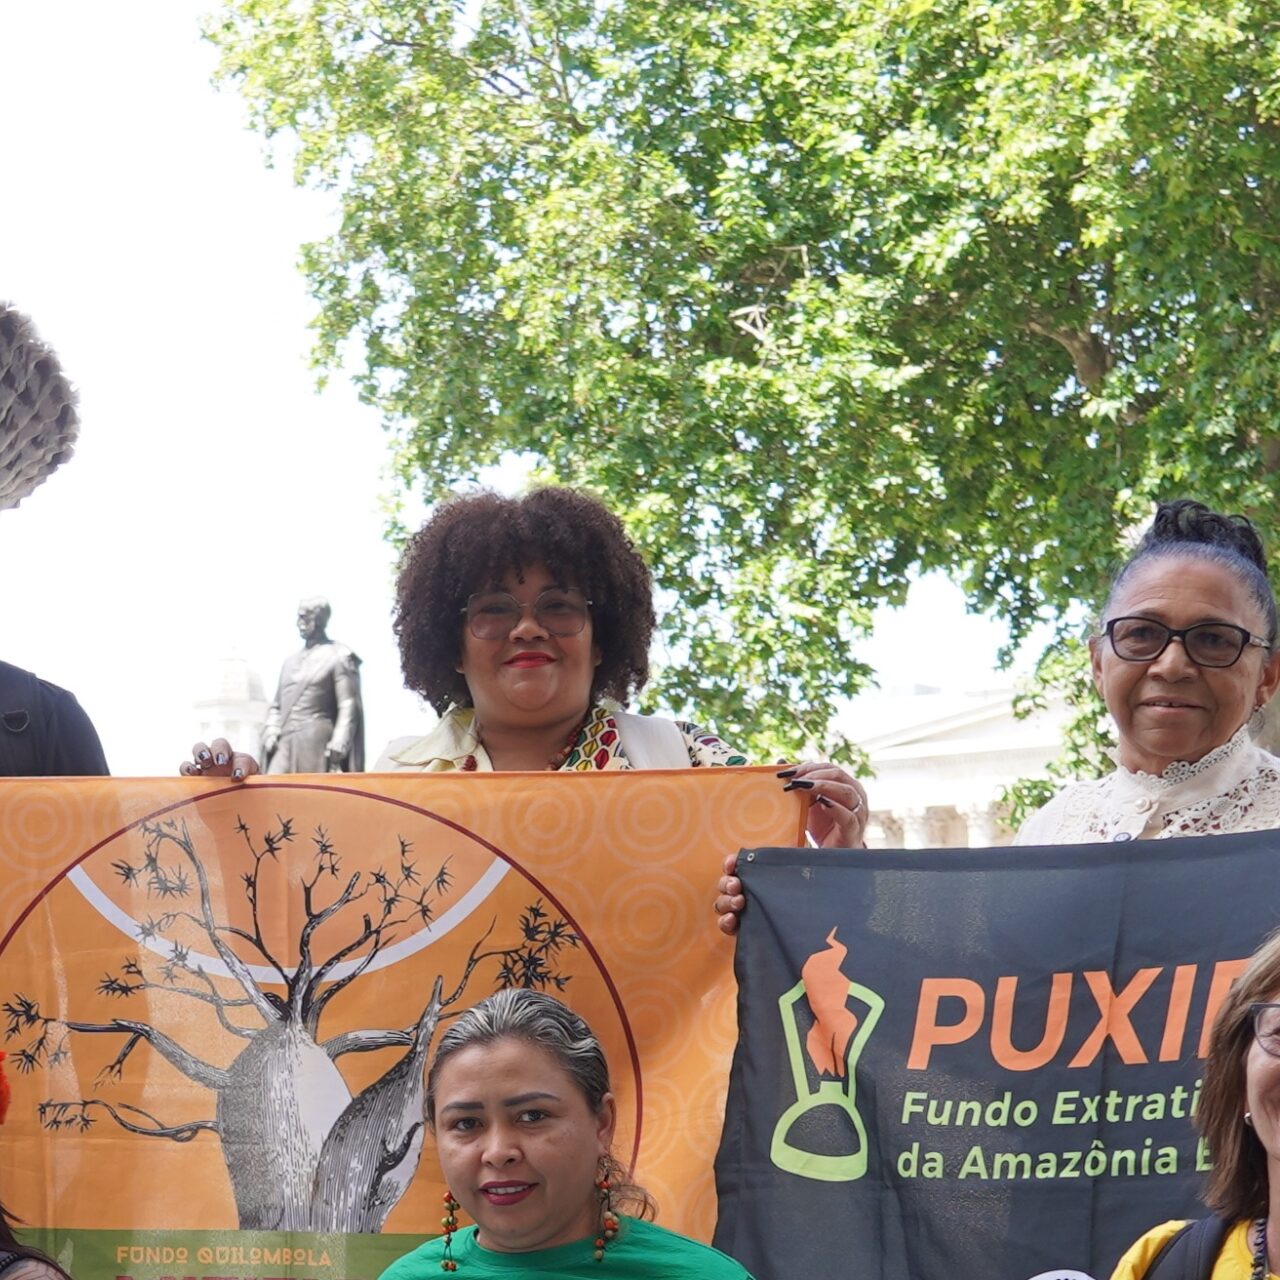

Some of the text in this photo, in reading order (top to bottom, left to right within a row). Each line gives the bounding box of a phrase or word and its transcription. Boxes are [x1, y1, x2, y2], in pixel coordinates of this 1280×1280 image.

[900, 1090, 1038, 1127] Fundo
[897, 1141, 943, 1179] da
[958, 1137, 1178, 1181] Amazônia
[116, 1246, 332, 1266] FUNDO QUILOMBOLA
